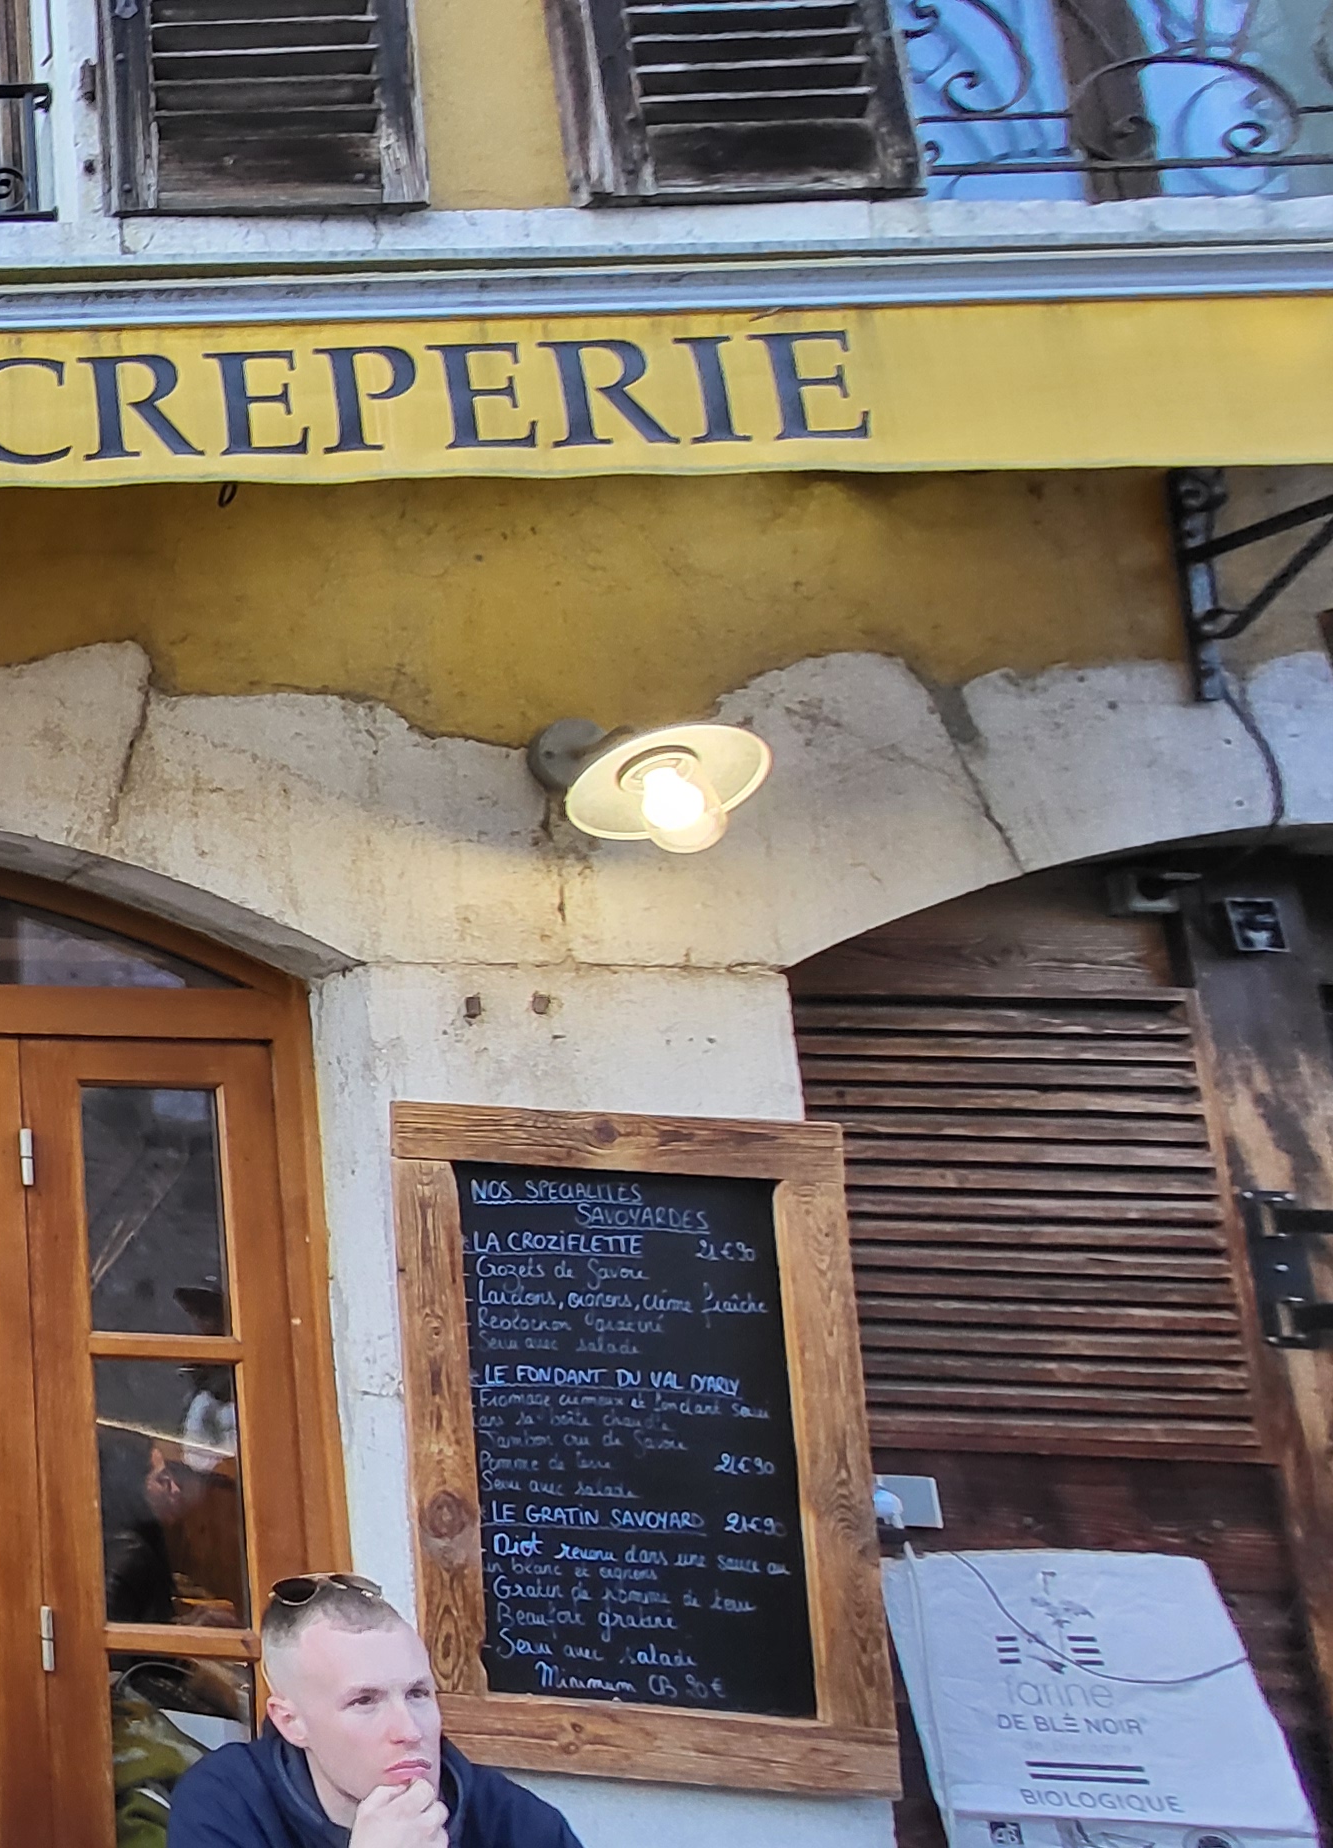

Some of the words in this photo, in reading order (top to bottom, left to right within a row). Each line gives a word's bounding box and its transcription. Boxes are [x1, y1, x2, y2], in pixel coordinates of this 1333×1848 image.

[470, 1178, 512, 1202] NOS
[575, 1203, 709, 1230] SAVOYARDES
[473, 1233, 501, 1252] LA
[485, 1365, 509, 1385] LE
[516, 1365, 608, 1385] FONDANT
[616, 1369, 642, 1386] DU
[651, 1371, 684, 1391] VAL
[491, 1501, 516, 1523] LE
[525, 1504, 599, 1525] GRATIN
[610, 1510, 705, 1529] SAVOYARD
[997, 1714, 1027, 1730] DE
[1084, 1718, 1143, 1735] NOIR
[1020, 1788, 1185, 1813] BIOLOGIQUE
